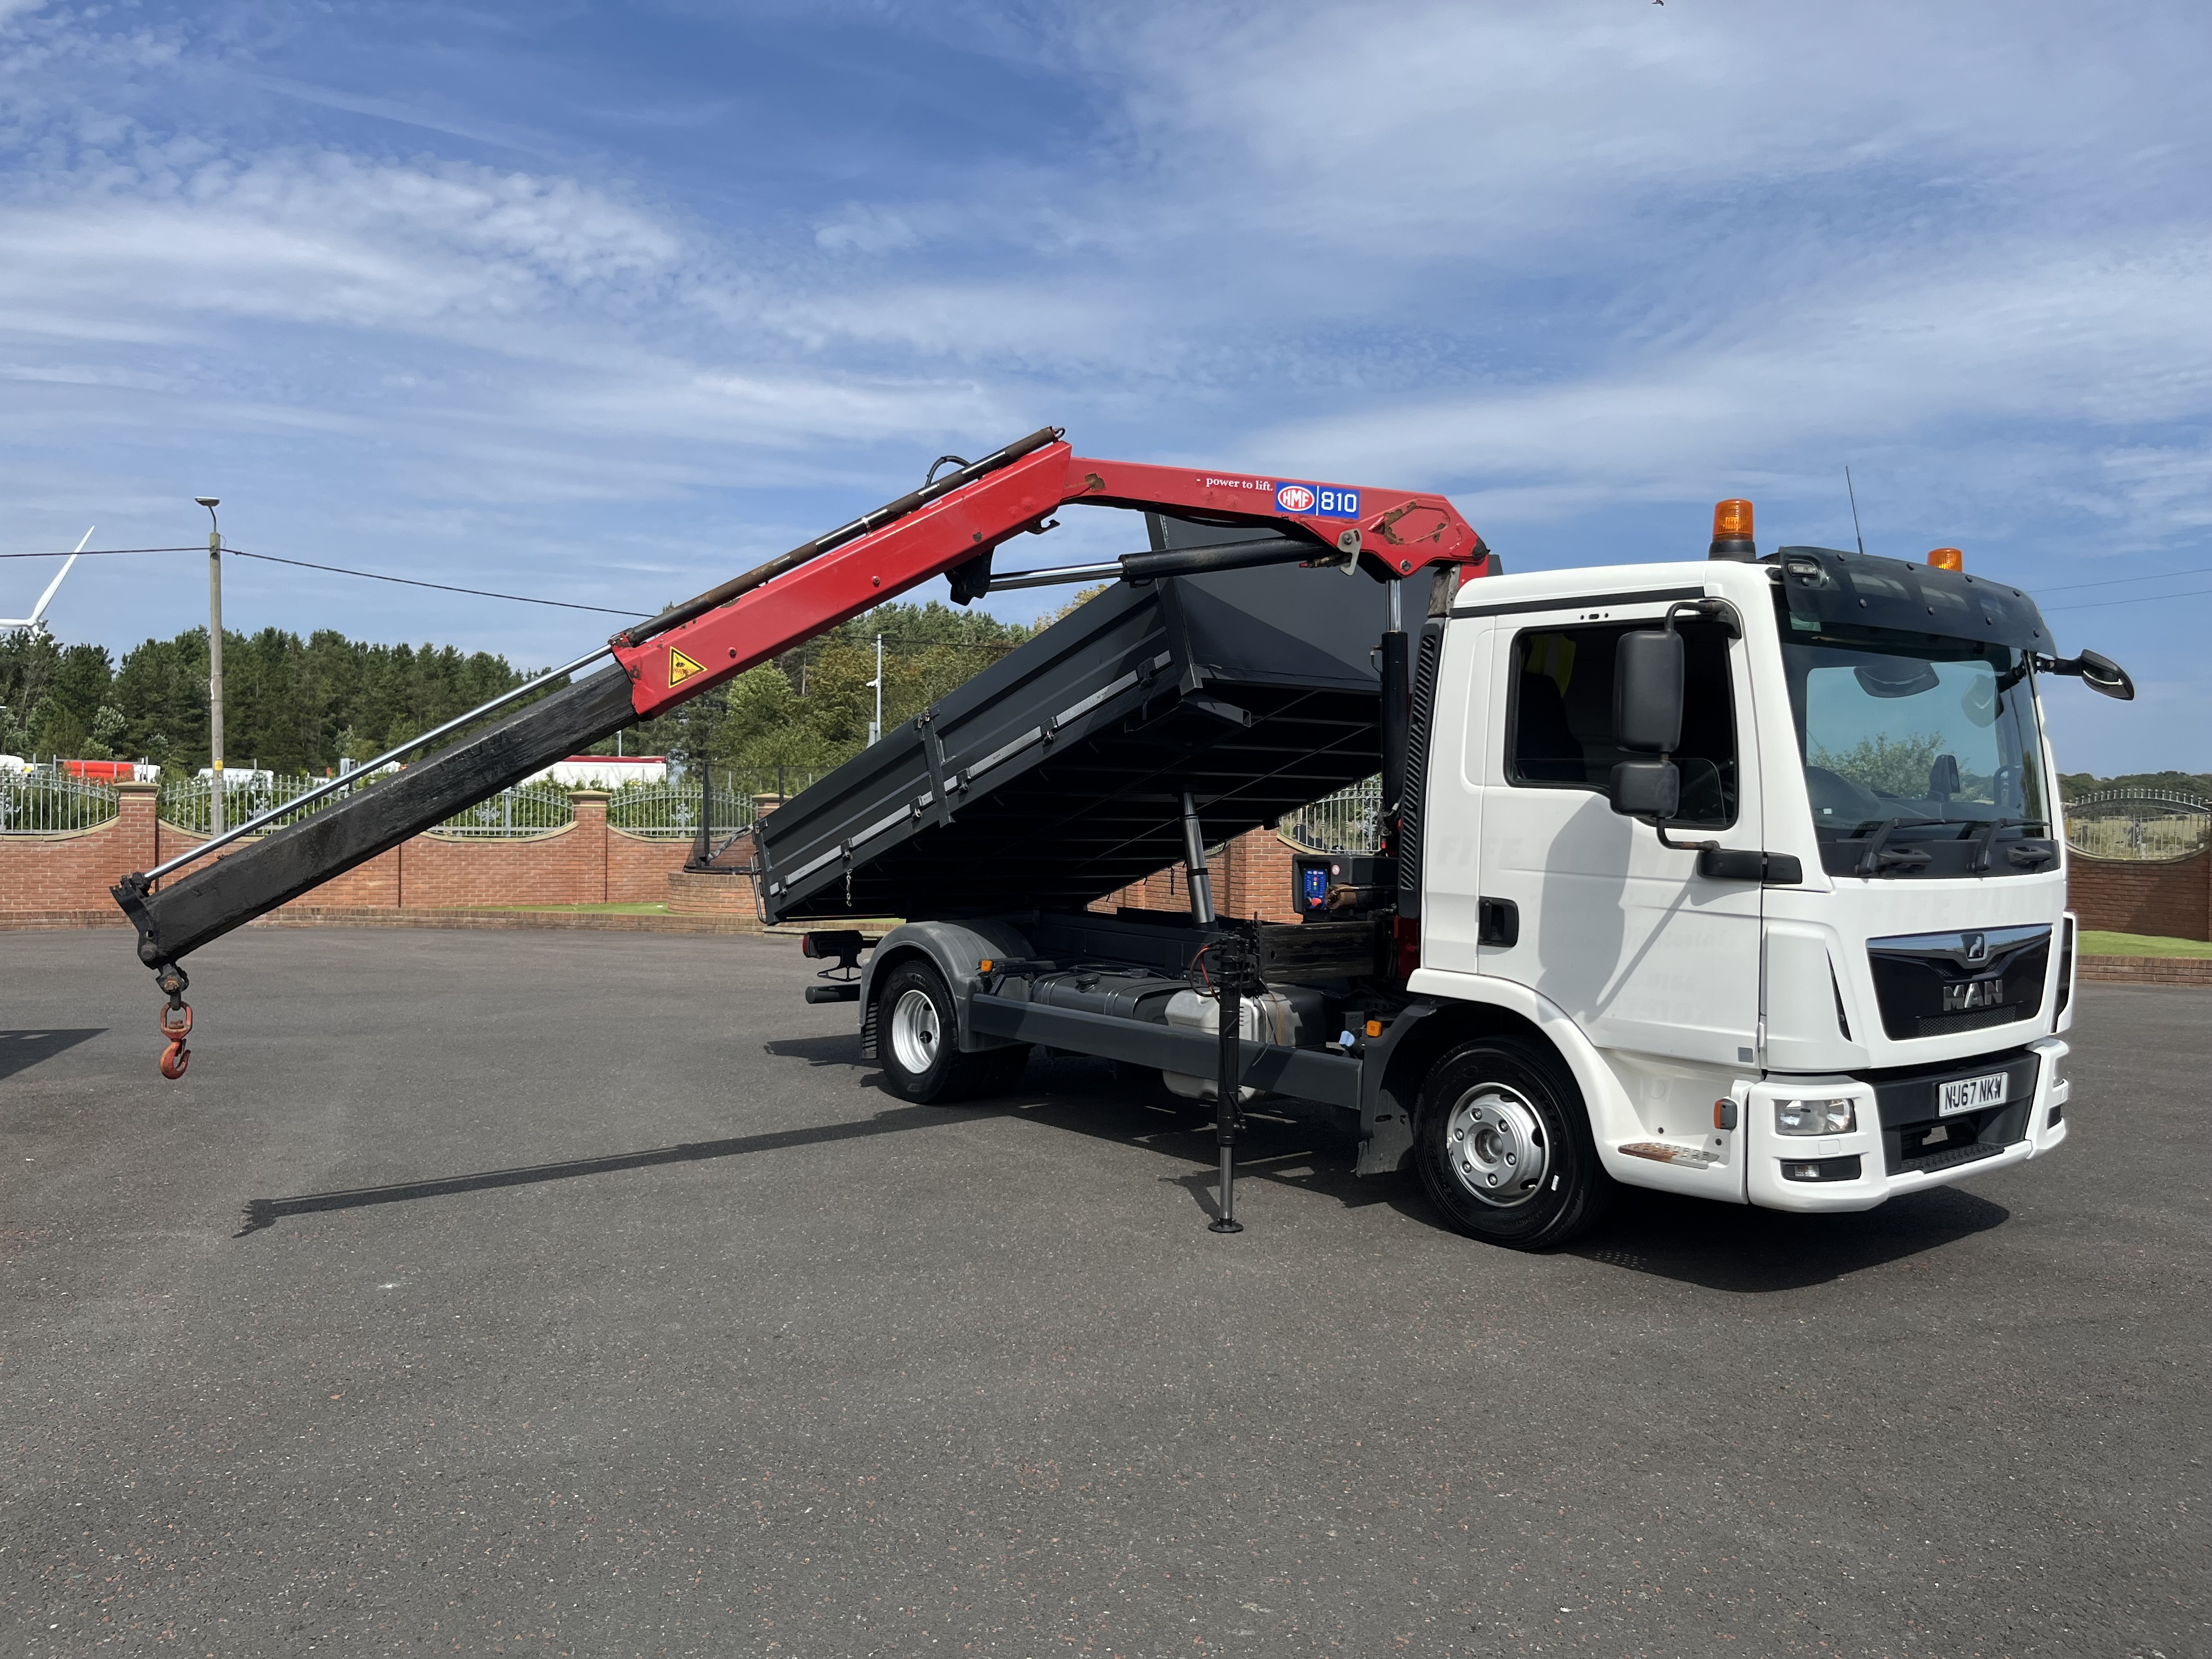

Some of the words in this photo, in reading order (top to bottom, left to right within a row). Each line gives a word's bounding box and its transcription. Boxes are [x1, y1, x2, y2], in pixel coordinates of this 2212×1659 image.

[1206, 478, 1240, 488] power
[1242, 481, 1252, 489] to
[1255, 481, 1273, 492] lift.
[1282, 489, 1310, 508] HMF
[1321, 492, 1357, 513] 810
[1943, 979, 2003, 1012] MAN
[1945, 1081, 1977, 1110] NU67
[1979, 1075, 2002, 1103] NKW
